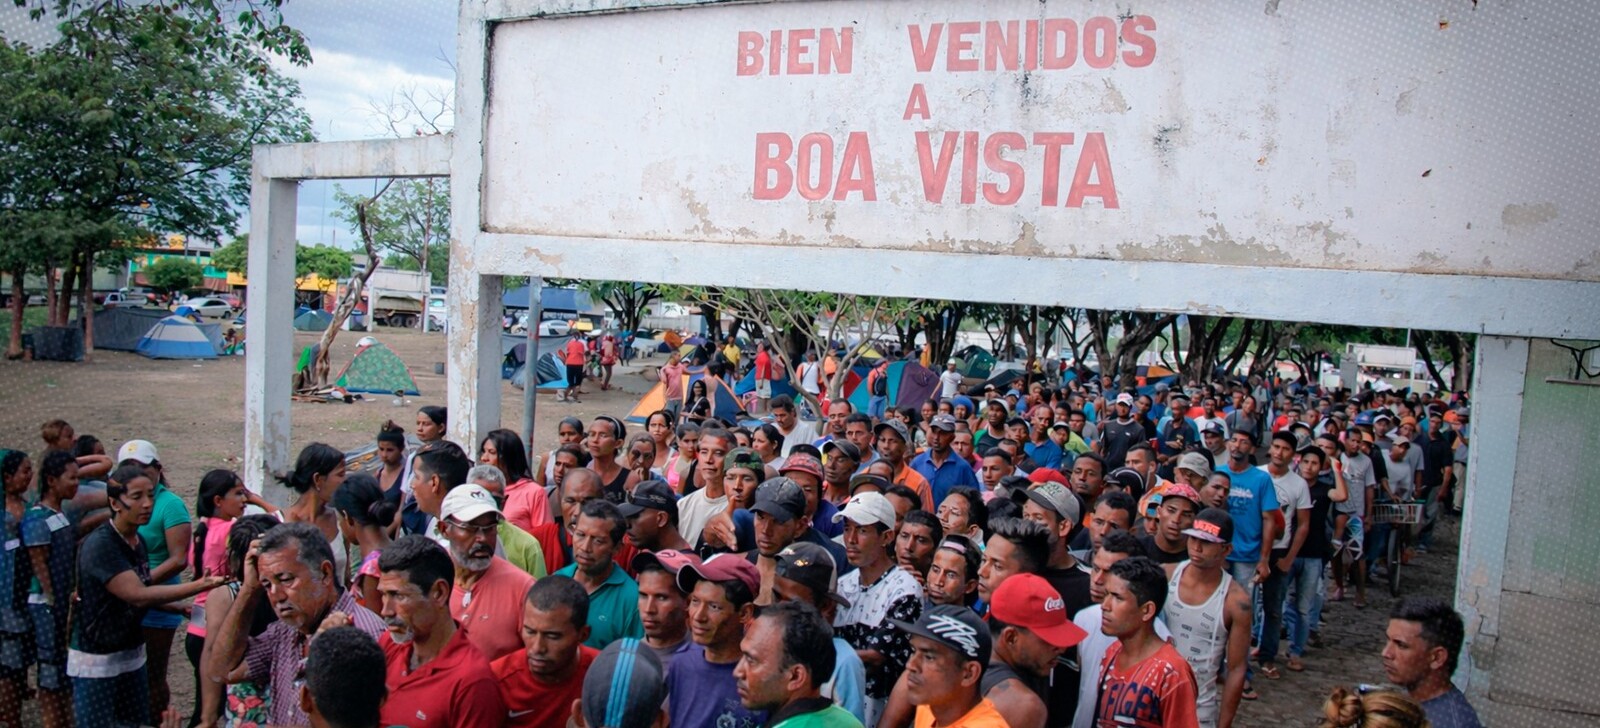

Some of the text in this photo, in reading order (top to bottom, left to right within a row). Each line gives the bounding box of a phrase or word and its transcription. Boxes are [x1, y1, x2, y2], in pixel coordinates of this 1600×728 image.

[737, 15, 1158, 75] BIEN VENIDOS
[903, 83, 931, 119] A
[753, 131, 1119, 209] BOA VISTA
